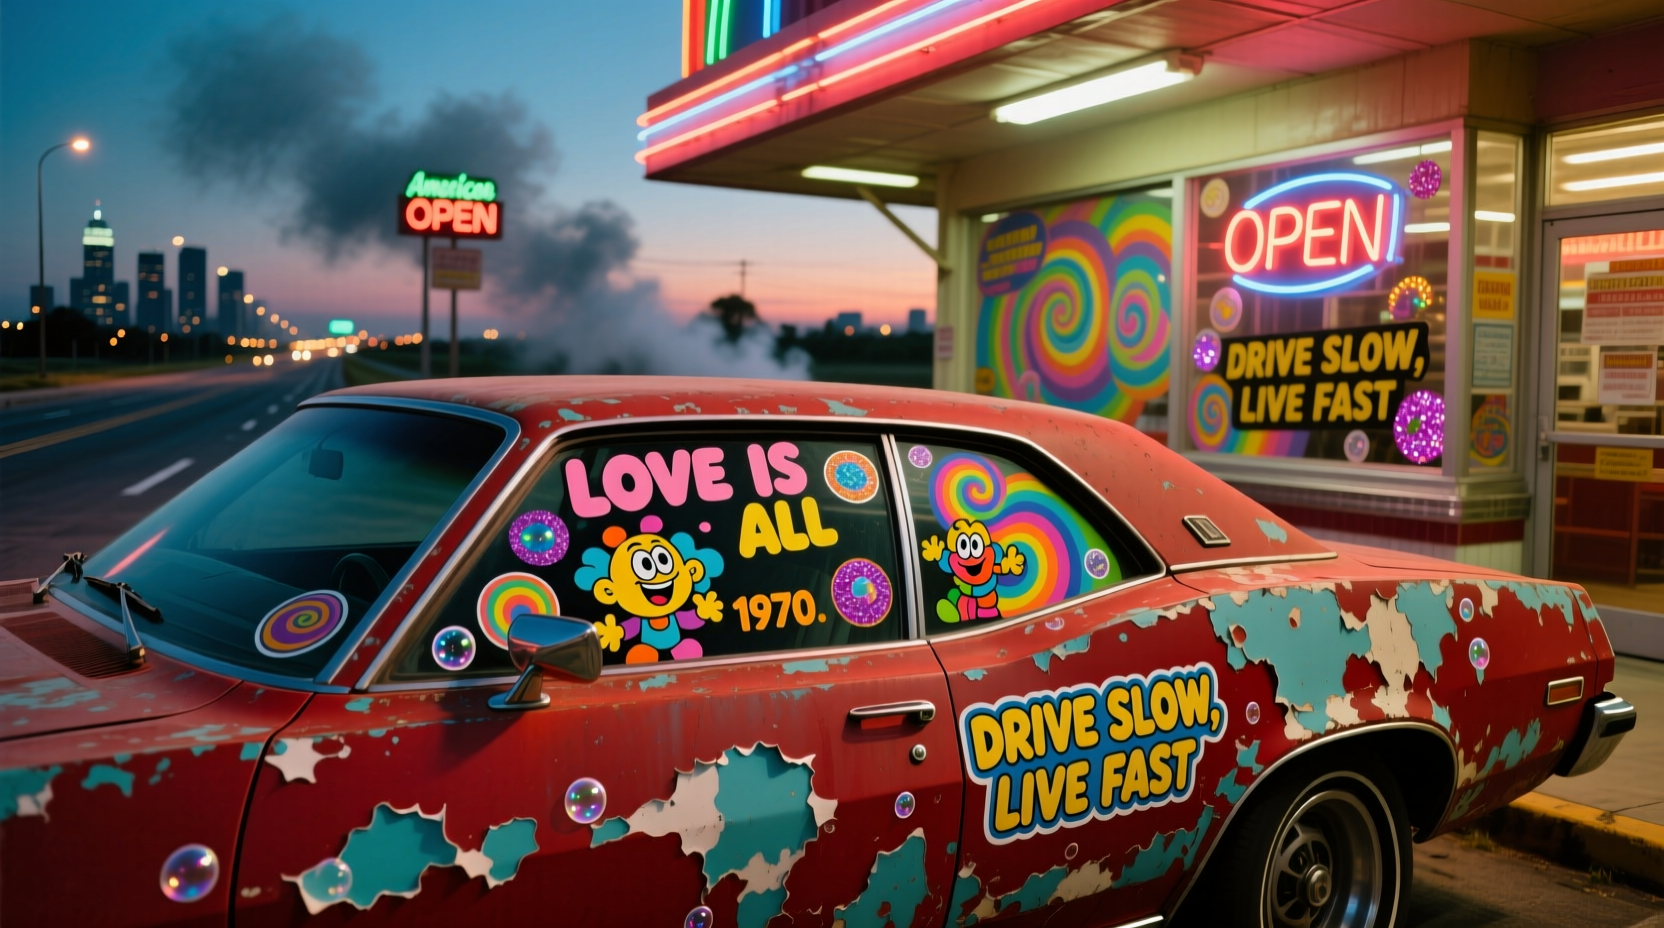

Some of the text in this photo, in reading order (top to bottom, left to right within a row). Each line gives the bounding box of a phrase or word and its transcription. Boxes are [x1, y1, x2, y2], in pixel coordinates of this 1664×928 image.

[405, 197, 498, 235] OPEN
[1224, 193, 1385, 274] OPEN
[1225, 337, 1315, 381] DRIVE
[1320, 328, 1425, 379] SLOW,
[1239, 379, 1398, 423] LIVE FAST
[565, 441, 808, 518] LOVE IS
[739, 496, 839, 559] ALL
[732, 589, 827, 632] 1970.
[969, 673, 1221, 771] DRIVE SLOW,
[994, 738, 1197, 832] LIVE FAST
